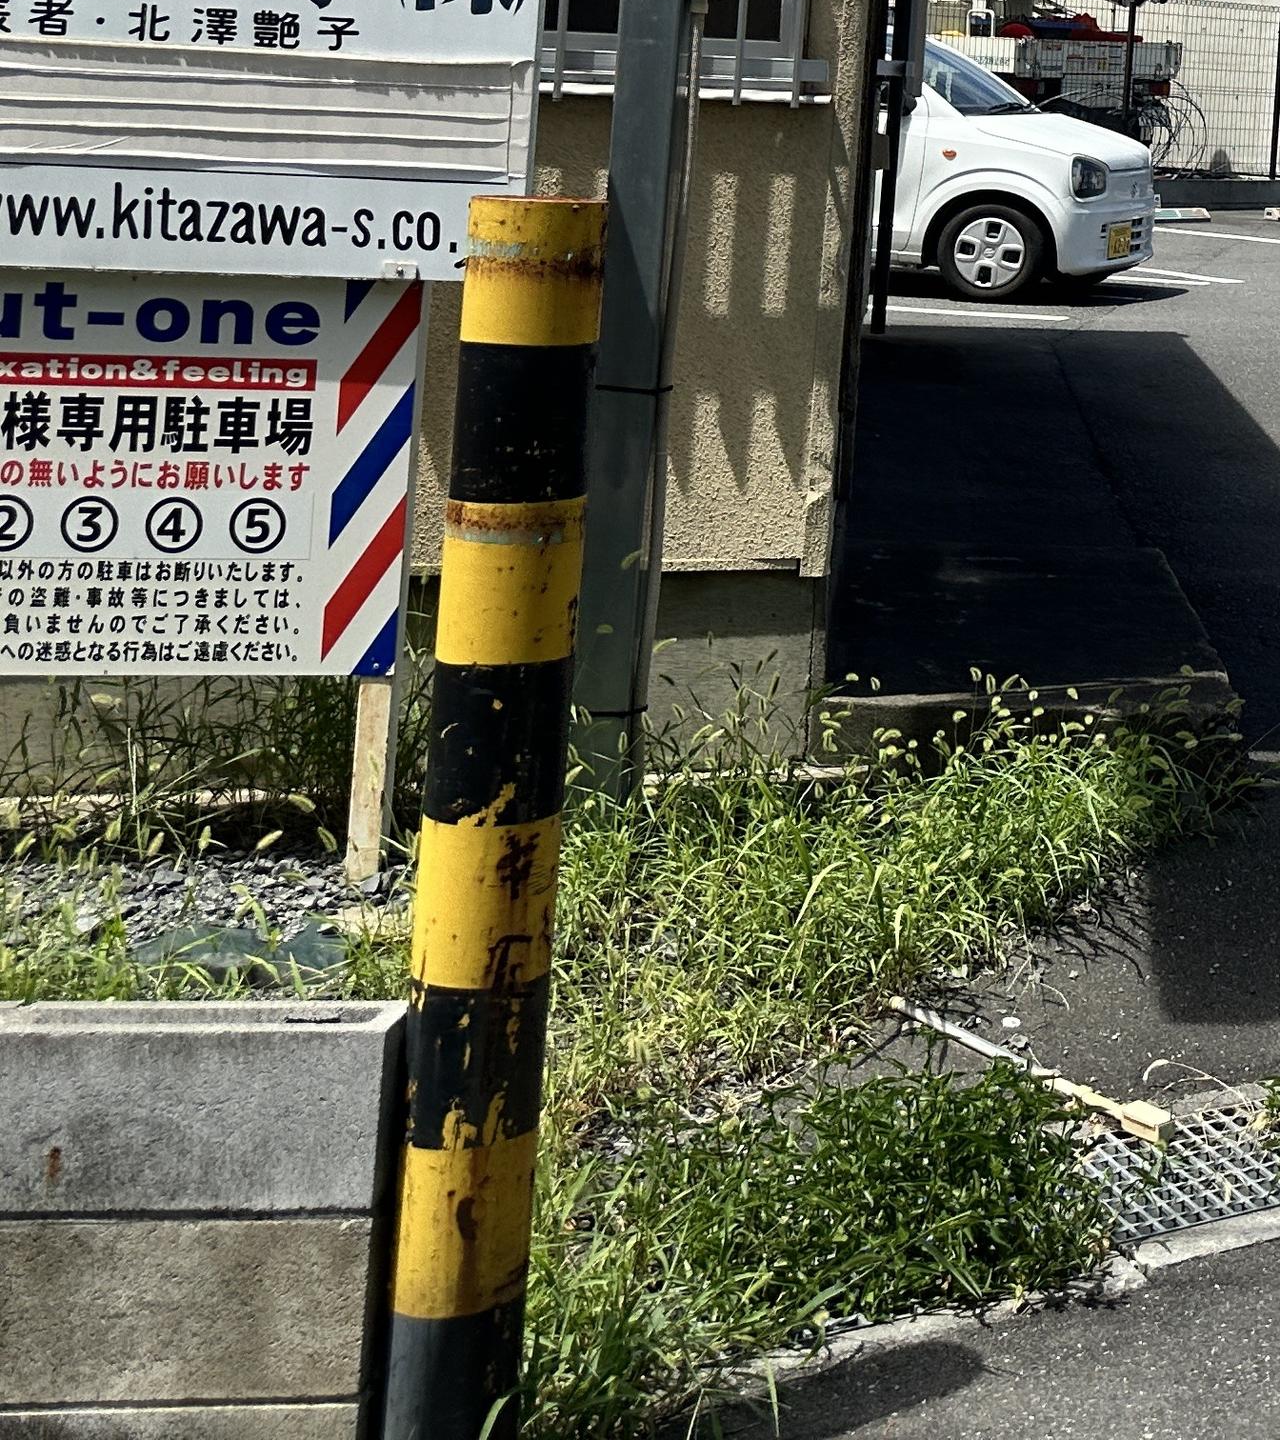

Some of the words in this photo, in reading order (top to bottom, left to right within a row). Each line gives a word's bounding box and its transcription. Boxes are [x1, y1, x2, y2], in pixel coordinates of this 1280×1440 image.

[1, 390, 314, 456] 様専用駐車場
[1, 458, 310, 491] の無いようにお願いします
[0, 586, 300, 608] の盗難・事故等につきましては、
[3, 613, 299, 635] 負いませんのでご了承ください。
